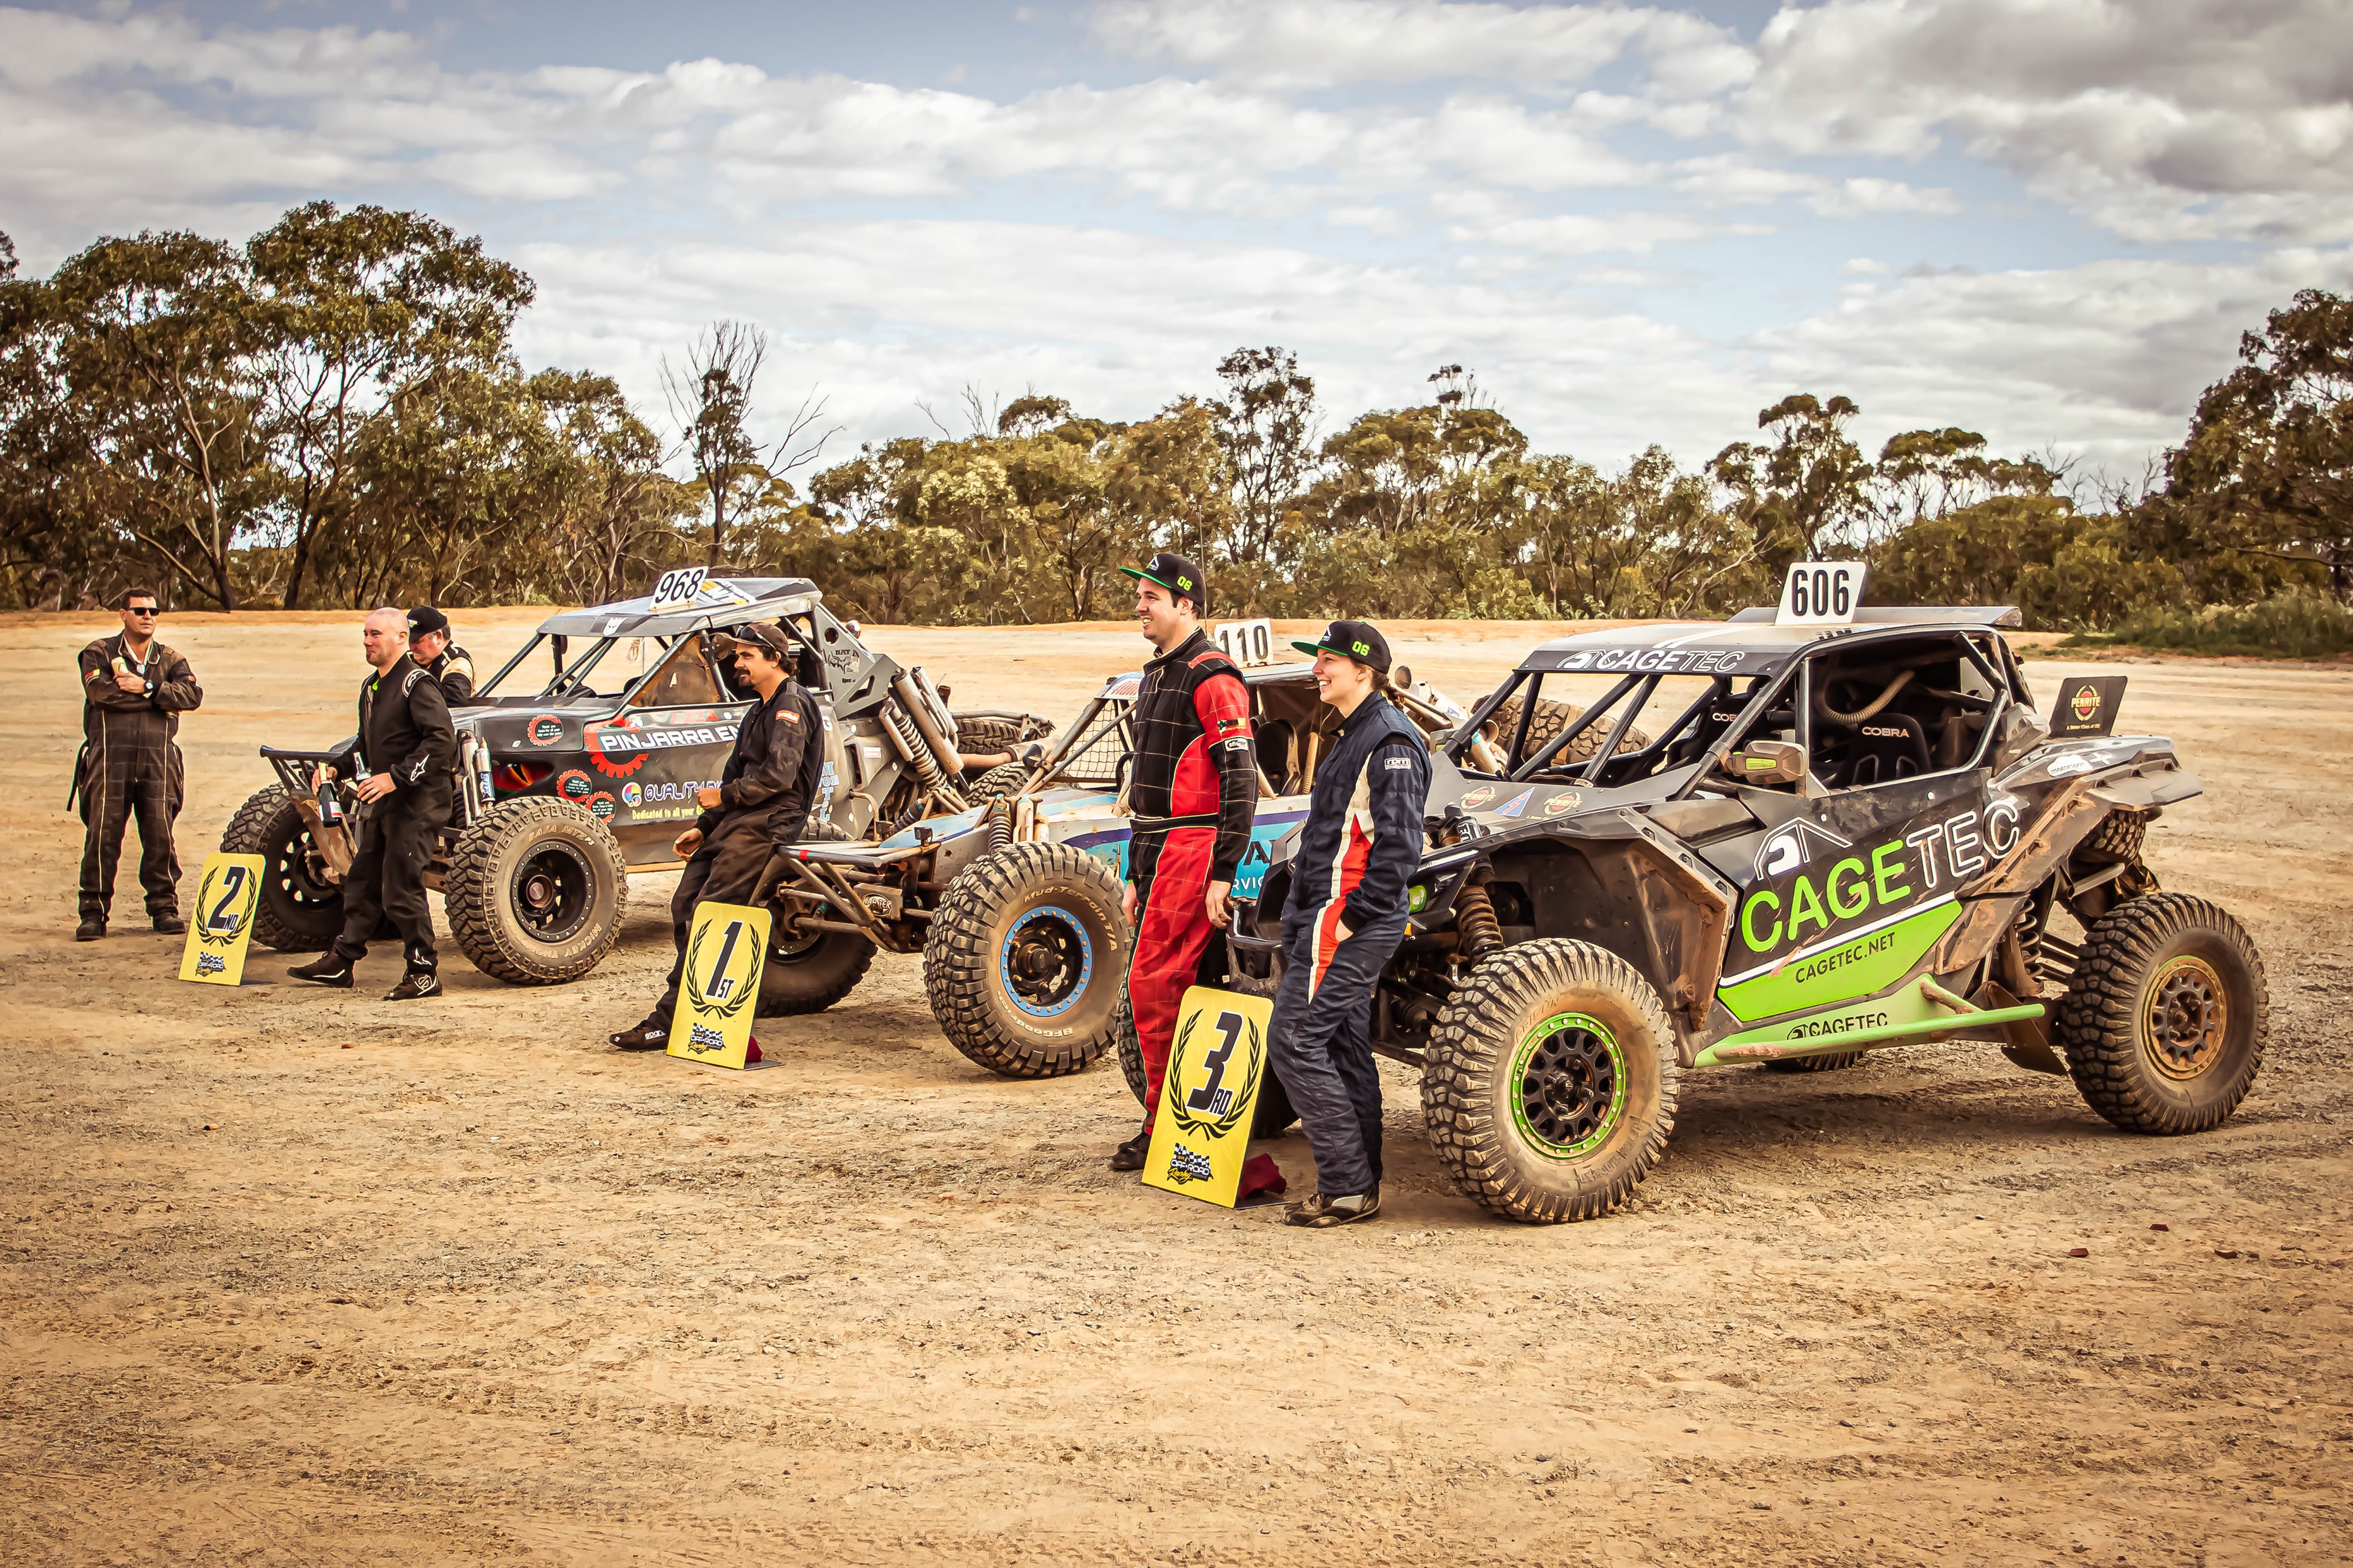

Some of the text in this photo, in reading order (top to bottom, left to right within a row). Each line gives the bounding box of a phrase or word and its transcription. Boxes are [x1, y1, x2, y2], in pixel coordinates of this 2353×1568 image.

[655, 569, 704, 604] 968
[1177, 576, 1193, 592] 06
[1792, 570, 1849, 616] 606
[1220, 625, 1268, 662] 110
[1352, 640, 1370, 656] 06
[1596, 649, 1745, 673] CAGETEC
[2071, 696, 2101, 708] PENRITE
[821, 715, 833, 732] G
[1712, 712, 1737, 722] COB
[600, 724, 739, 751] PINJARRA EN
[1862, 727, 1911, 738] COBRA
[632, 809, 663, 820] Dedicated
[672, 806, 680, 817] all
[681, 808, 695, 819] your
[696, 804, 706, 816] Gr
[1544, 798, 1582, 808] PENRITE
[529, 825, 557, 843] BAJA
[1742, 801, 2020, 953] CAGETEC
[207, 866, 246, 930] 2ND
[1022, 886, 1118, 952] Mud-Terrain T/A
[564, 922, 603, 959] MICKEY
[705, 921, 743, 999] 1ST
[1795, 932, 1895, 983] CAGETEC.NET
[1808, 1011, 1888, 1037] CAGETEC
[1186, 1011, 1243, 1116] 3RD
[1167, 1167, 1193, 1183] Racing
